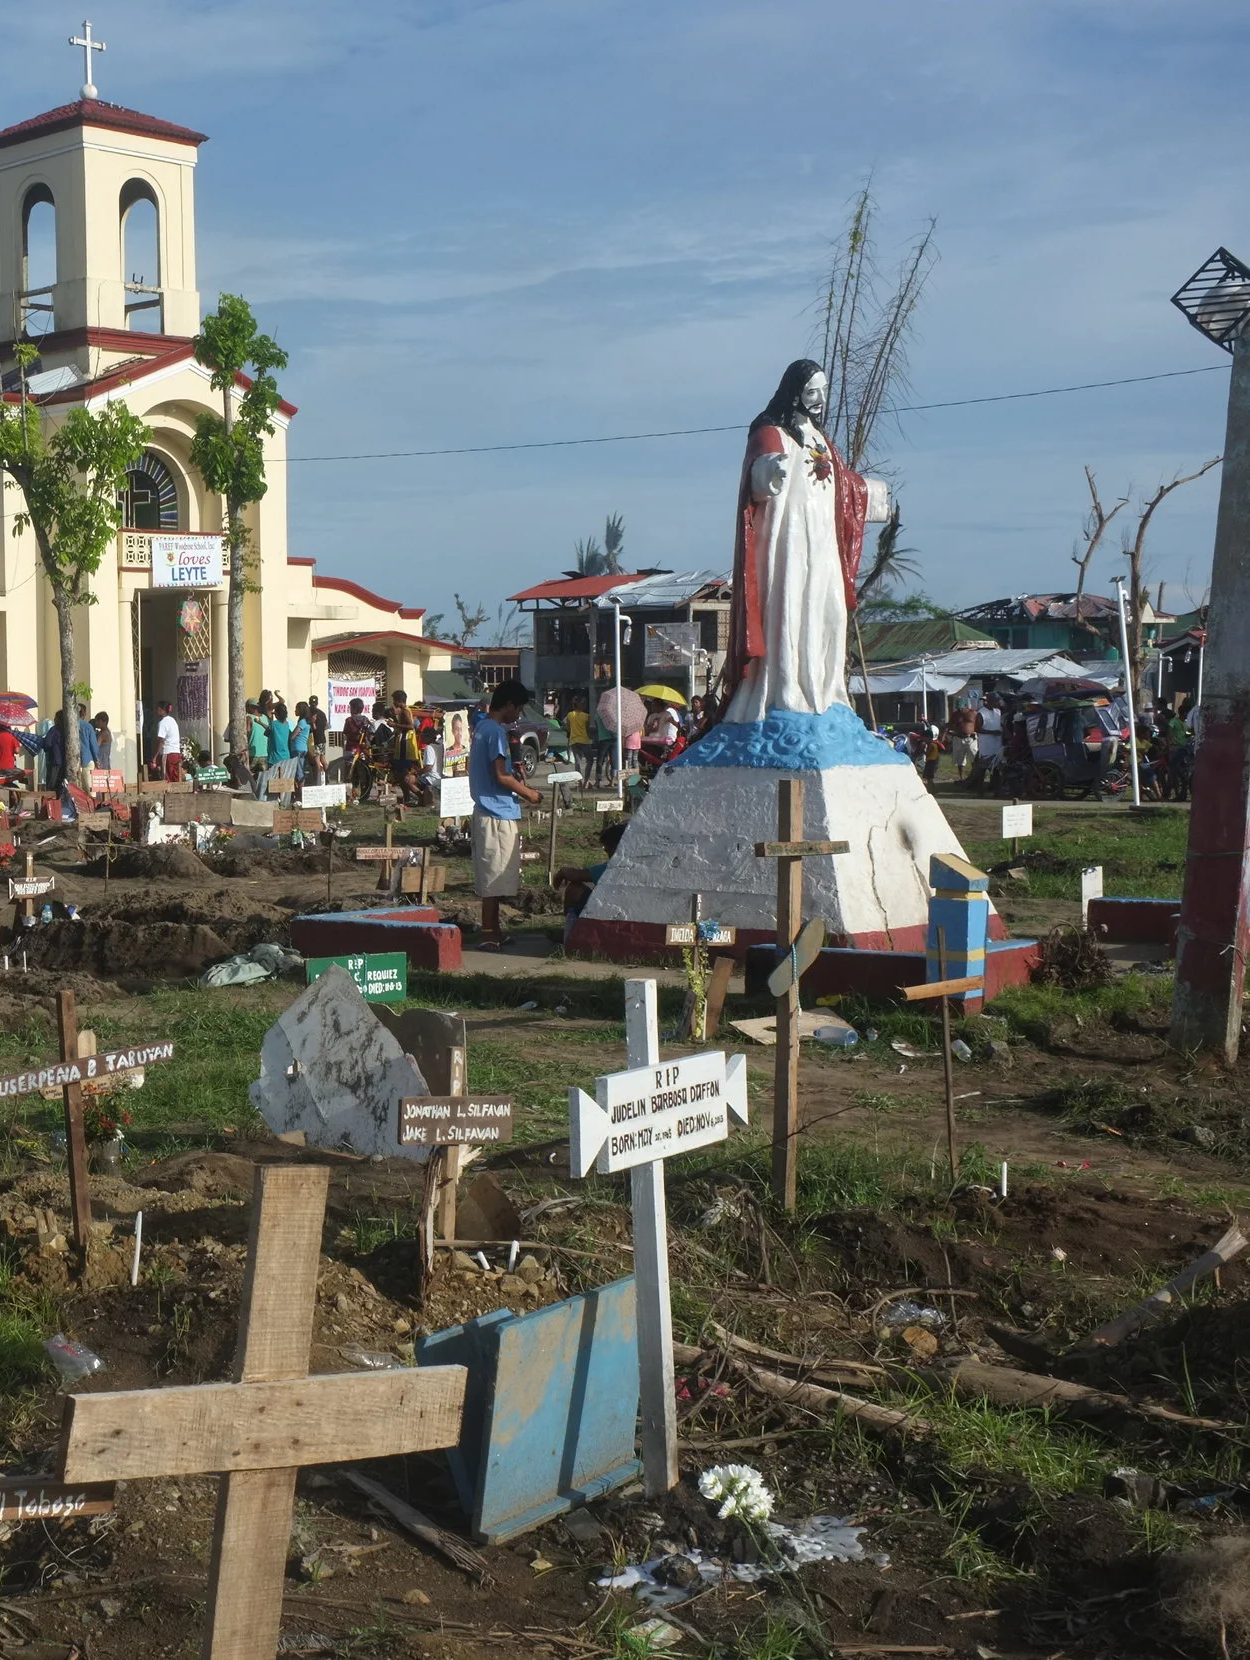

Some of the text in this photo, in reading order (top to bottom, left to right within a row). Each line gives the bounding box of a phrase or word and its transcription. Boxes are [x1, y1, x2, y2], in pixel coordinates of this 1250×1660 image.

[178, 552, 211, 566] loves
[171, 567, 207, 581] LEYTE
[670, 927, 694, 943] IMELDA
[347, 958, 364, 970] RIP
[367, 969, 398, 981] REQUIEZ
[87, 1058, 97, 1077] B
[105, 1043, 174, 1072] TABUYAN
[404, 1104, 451, 1120] JONATHAN
[467, 1103, 511, 1118] SILFAVAN
[611, 1097, 646, 1124] JUDELIN
[402, 1125, 427, 1142] JAKE
[447, 1125, 500, 1142] SILFAVAN
